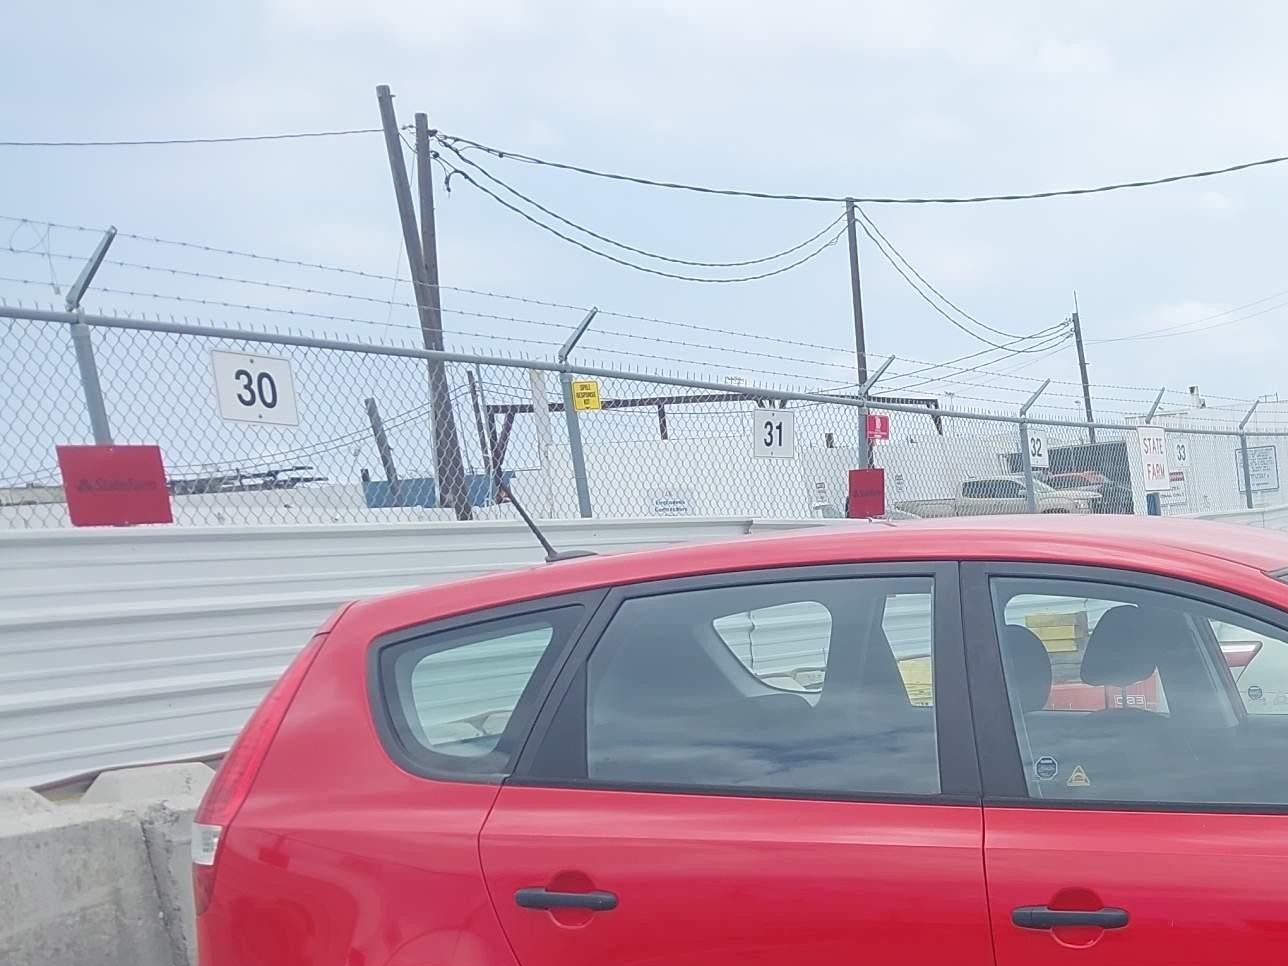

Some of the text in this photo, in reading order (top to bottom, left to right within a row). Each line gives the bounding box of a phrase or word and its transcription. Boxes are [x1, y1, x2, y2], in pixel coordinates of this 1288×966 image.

[234, 368, 278, 409] 30
[763, 420, 783, 447] 31
[1030, 437, 1043, 457] 32
[1142, 437, 1164, 455] STATE
[1176, 444, 1187, 461] 33
[1146, 463, 1166, 481] FARM
